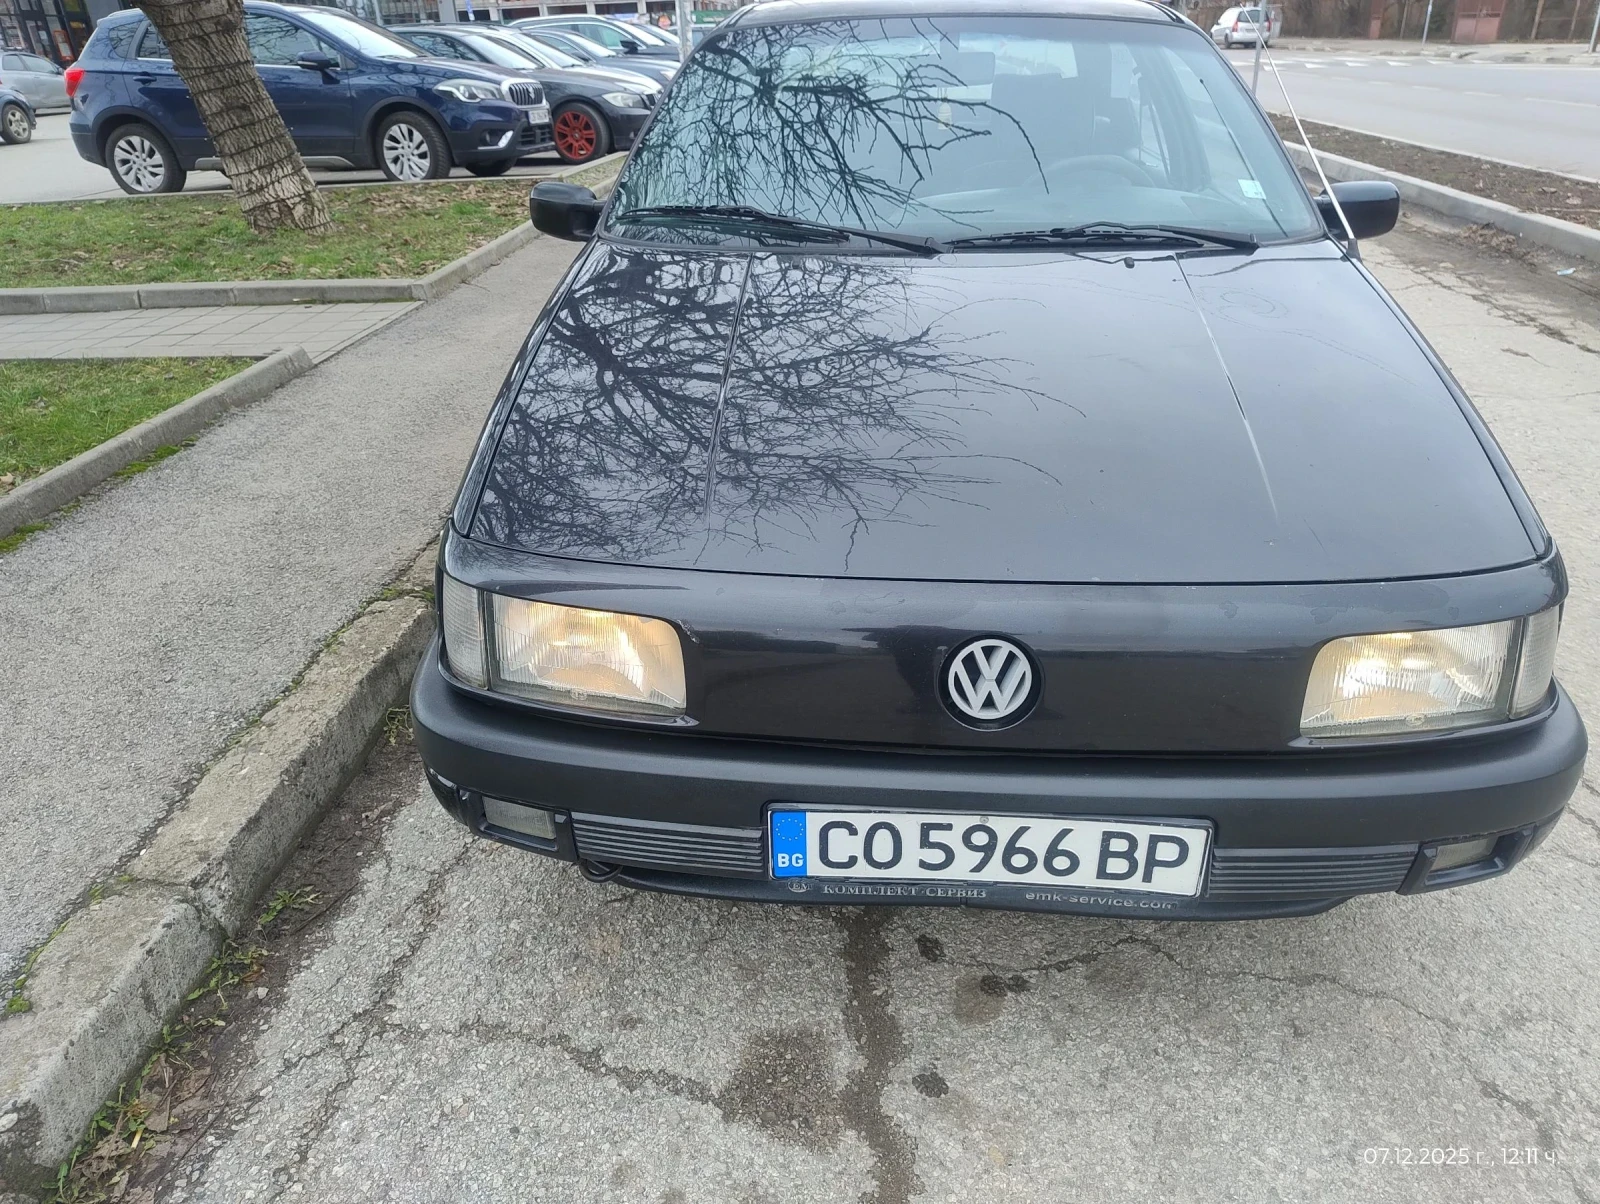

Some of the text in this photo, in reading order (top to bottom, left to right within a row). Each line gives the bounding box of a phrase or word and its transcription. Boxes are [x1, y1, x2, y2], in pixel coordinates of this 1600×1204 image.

[777, 852, 805, 868] BG
[918, 822, 1080, 877] 5966
[1095, 830, 1190, 884] BP
[1025, 891, 1179, 910] emk-service.com
